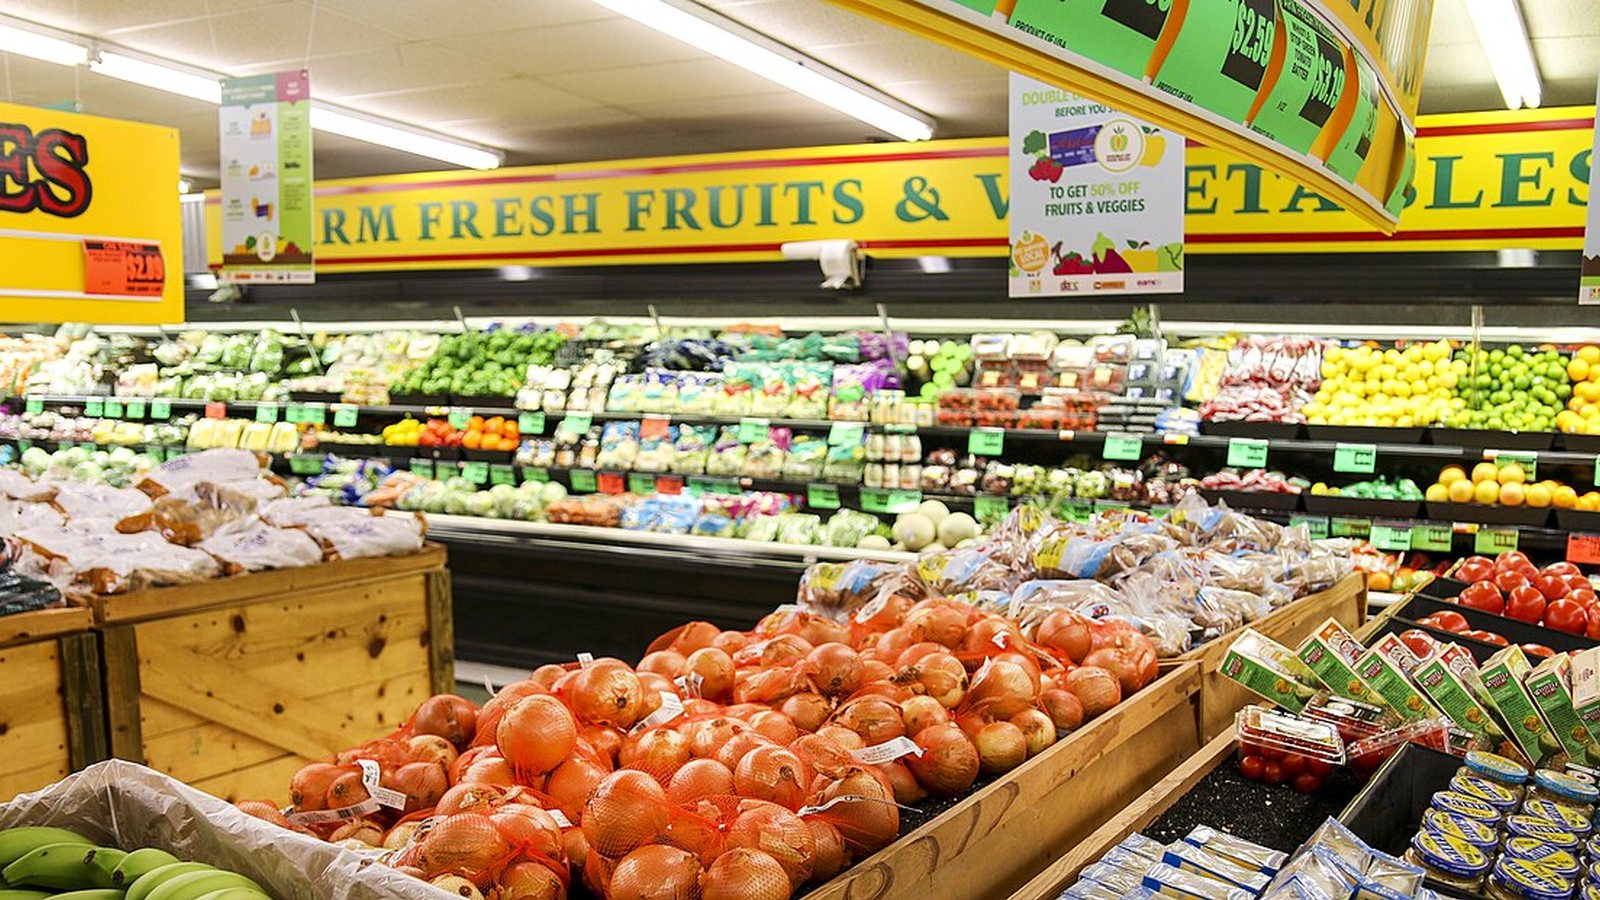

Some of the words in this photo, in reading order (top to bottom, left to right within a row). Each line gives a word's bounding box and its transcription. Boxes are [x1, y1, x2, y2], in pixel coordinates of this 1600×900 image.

[1231, 2, 1275, 67] $2.59
[1022, 89, 1069, 106] DOUBLE
[1055, 105, 1087, 117] BEFORE
[1088, 104, 1106, 114] YOU
[1050, 186, 1064, 199] TO
[1067, 185, 1088, 198] GET
[1091, 183, 1115, 196] 50%
[1119, 181, 1141, 195] OFF
[314, 203, 399, 245] RM
[417, 192, 602, 241] FRESH
[623, 179, 865, 232] FRUITS
[895, 175, 950, 224] &
[1045, 203, 1083, 216] FRUITS
[1085, 201, 1094, 214] &
[1097, 199, 1145, 213] VEGGIES
